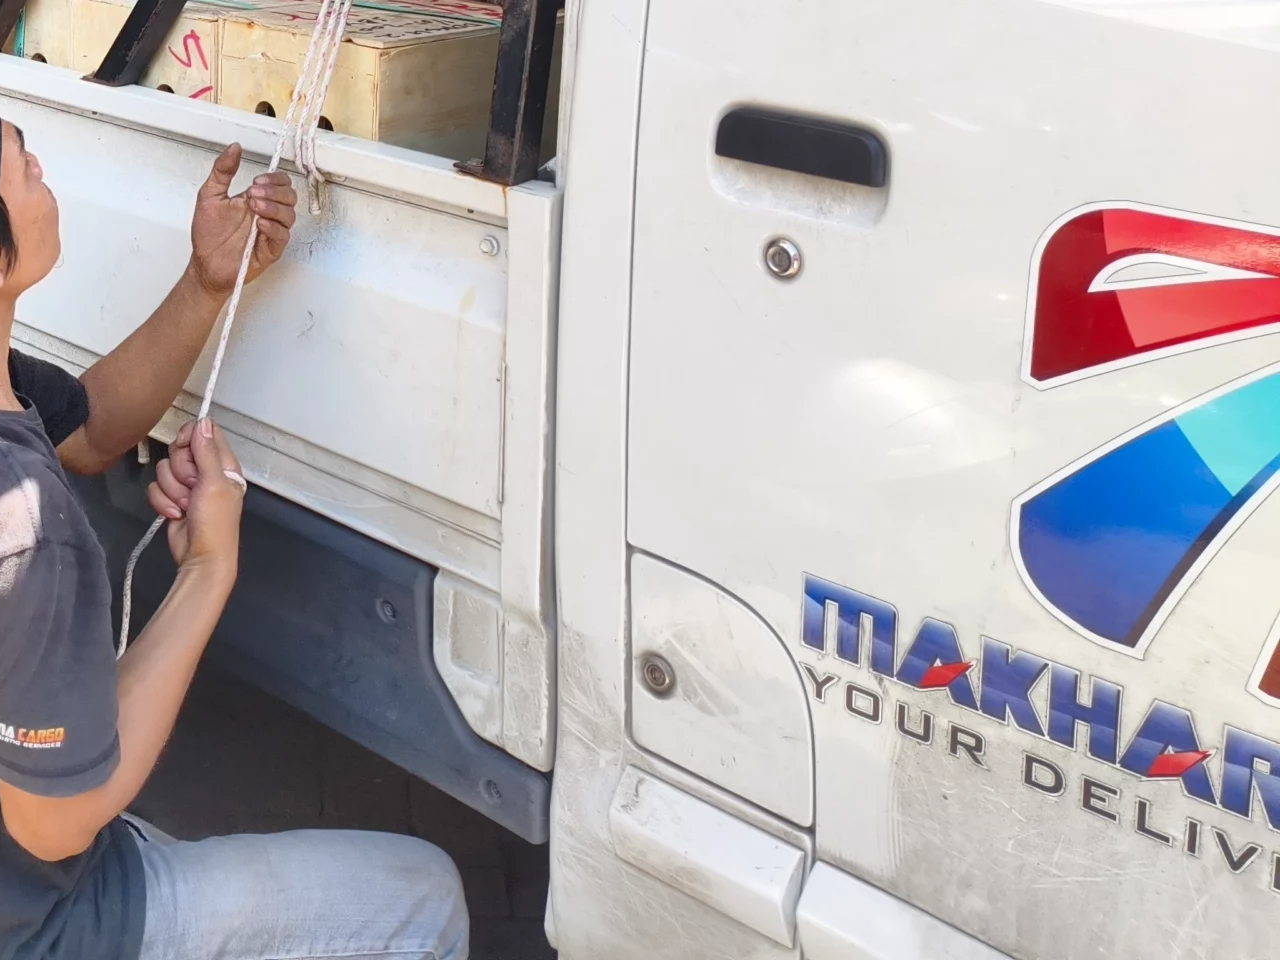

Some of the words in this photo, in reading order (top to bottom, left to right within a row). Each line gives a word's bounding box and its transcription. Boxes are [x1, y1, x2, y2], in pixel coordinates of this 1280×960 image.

[17, 727, 65, 743] CARGO
[800, 661, 989, 768] YOUR
[1023, 750, 1280, 897] DELIV
